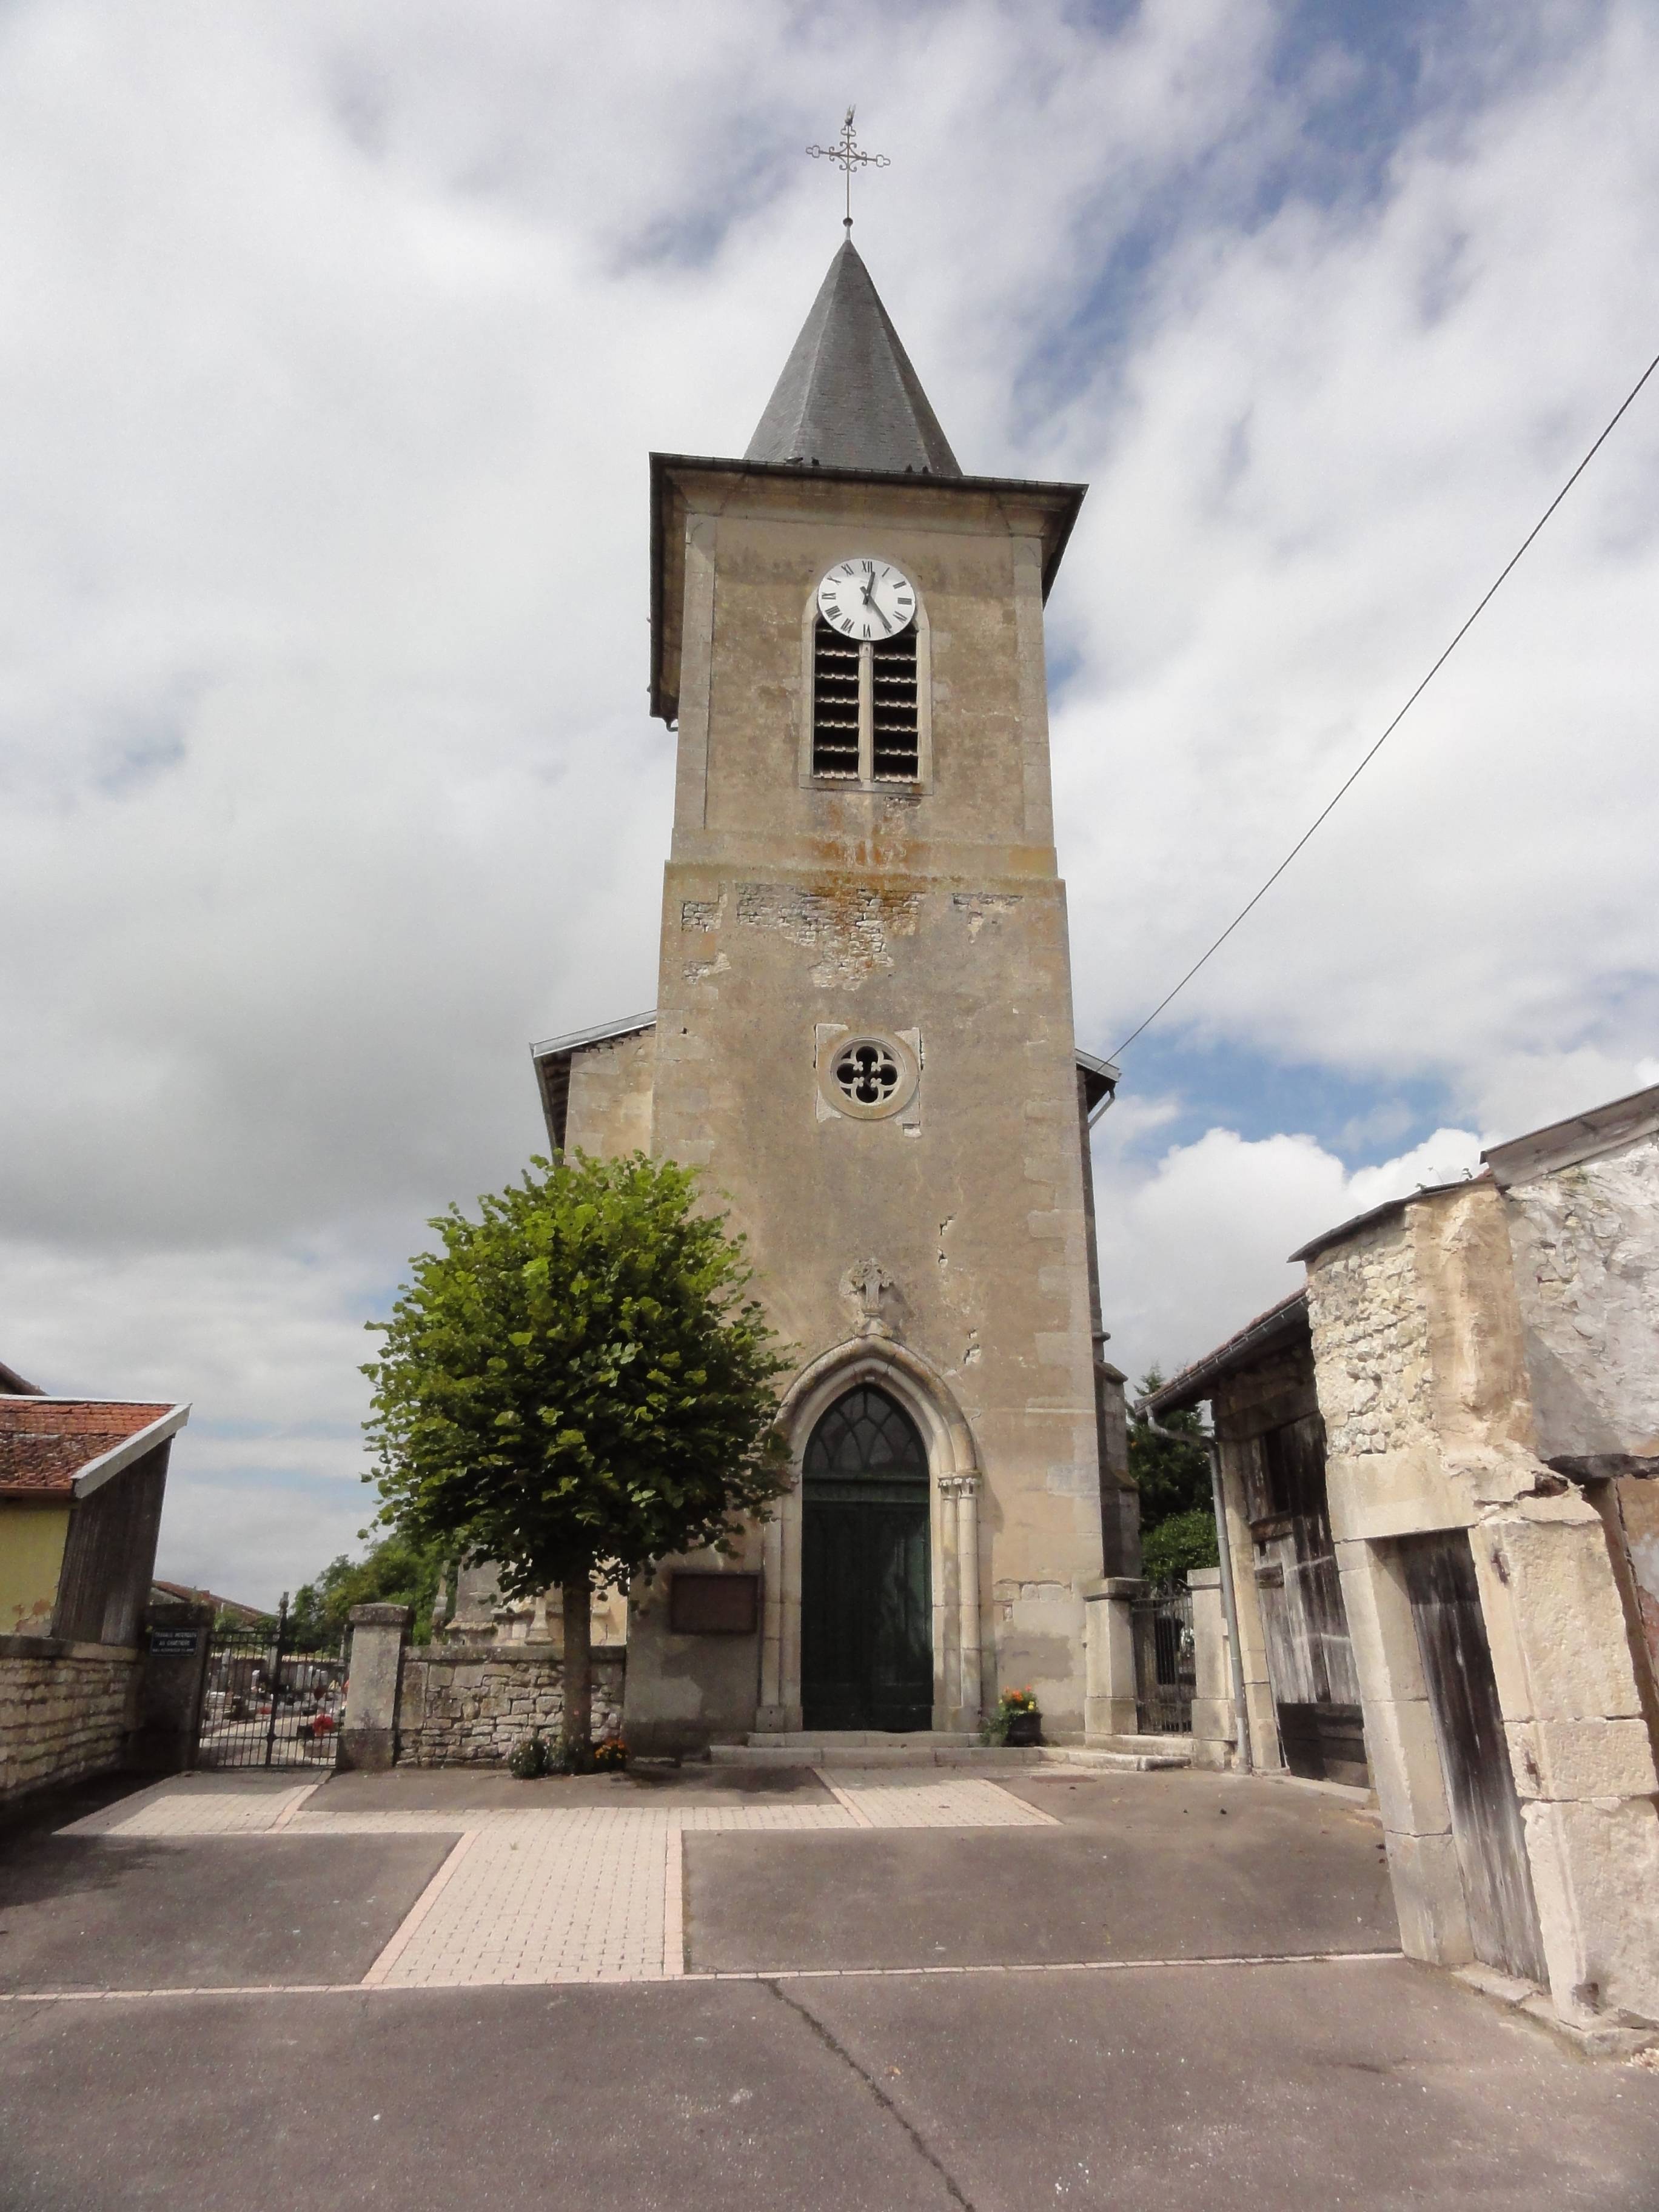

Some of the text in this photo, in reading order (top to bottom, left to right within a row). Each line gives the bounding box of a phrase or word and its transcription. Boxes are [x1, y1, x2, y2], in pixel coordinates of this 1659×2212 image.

[841, 563, 854, 576] XI
[862, 561, 873, 573] XII
[826, 576, 842, 585] X
[840, 618, 854, 634] VII
[863, 624, 871, 637] VI
